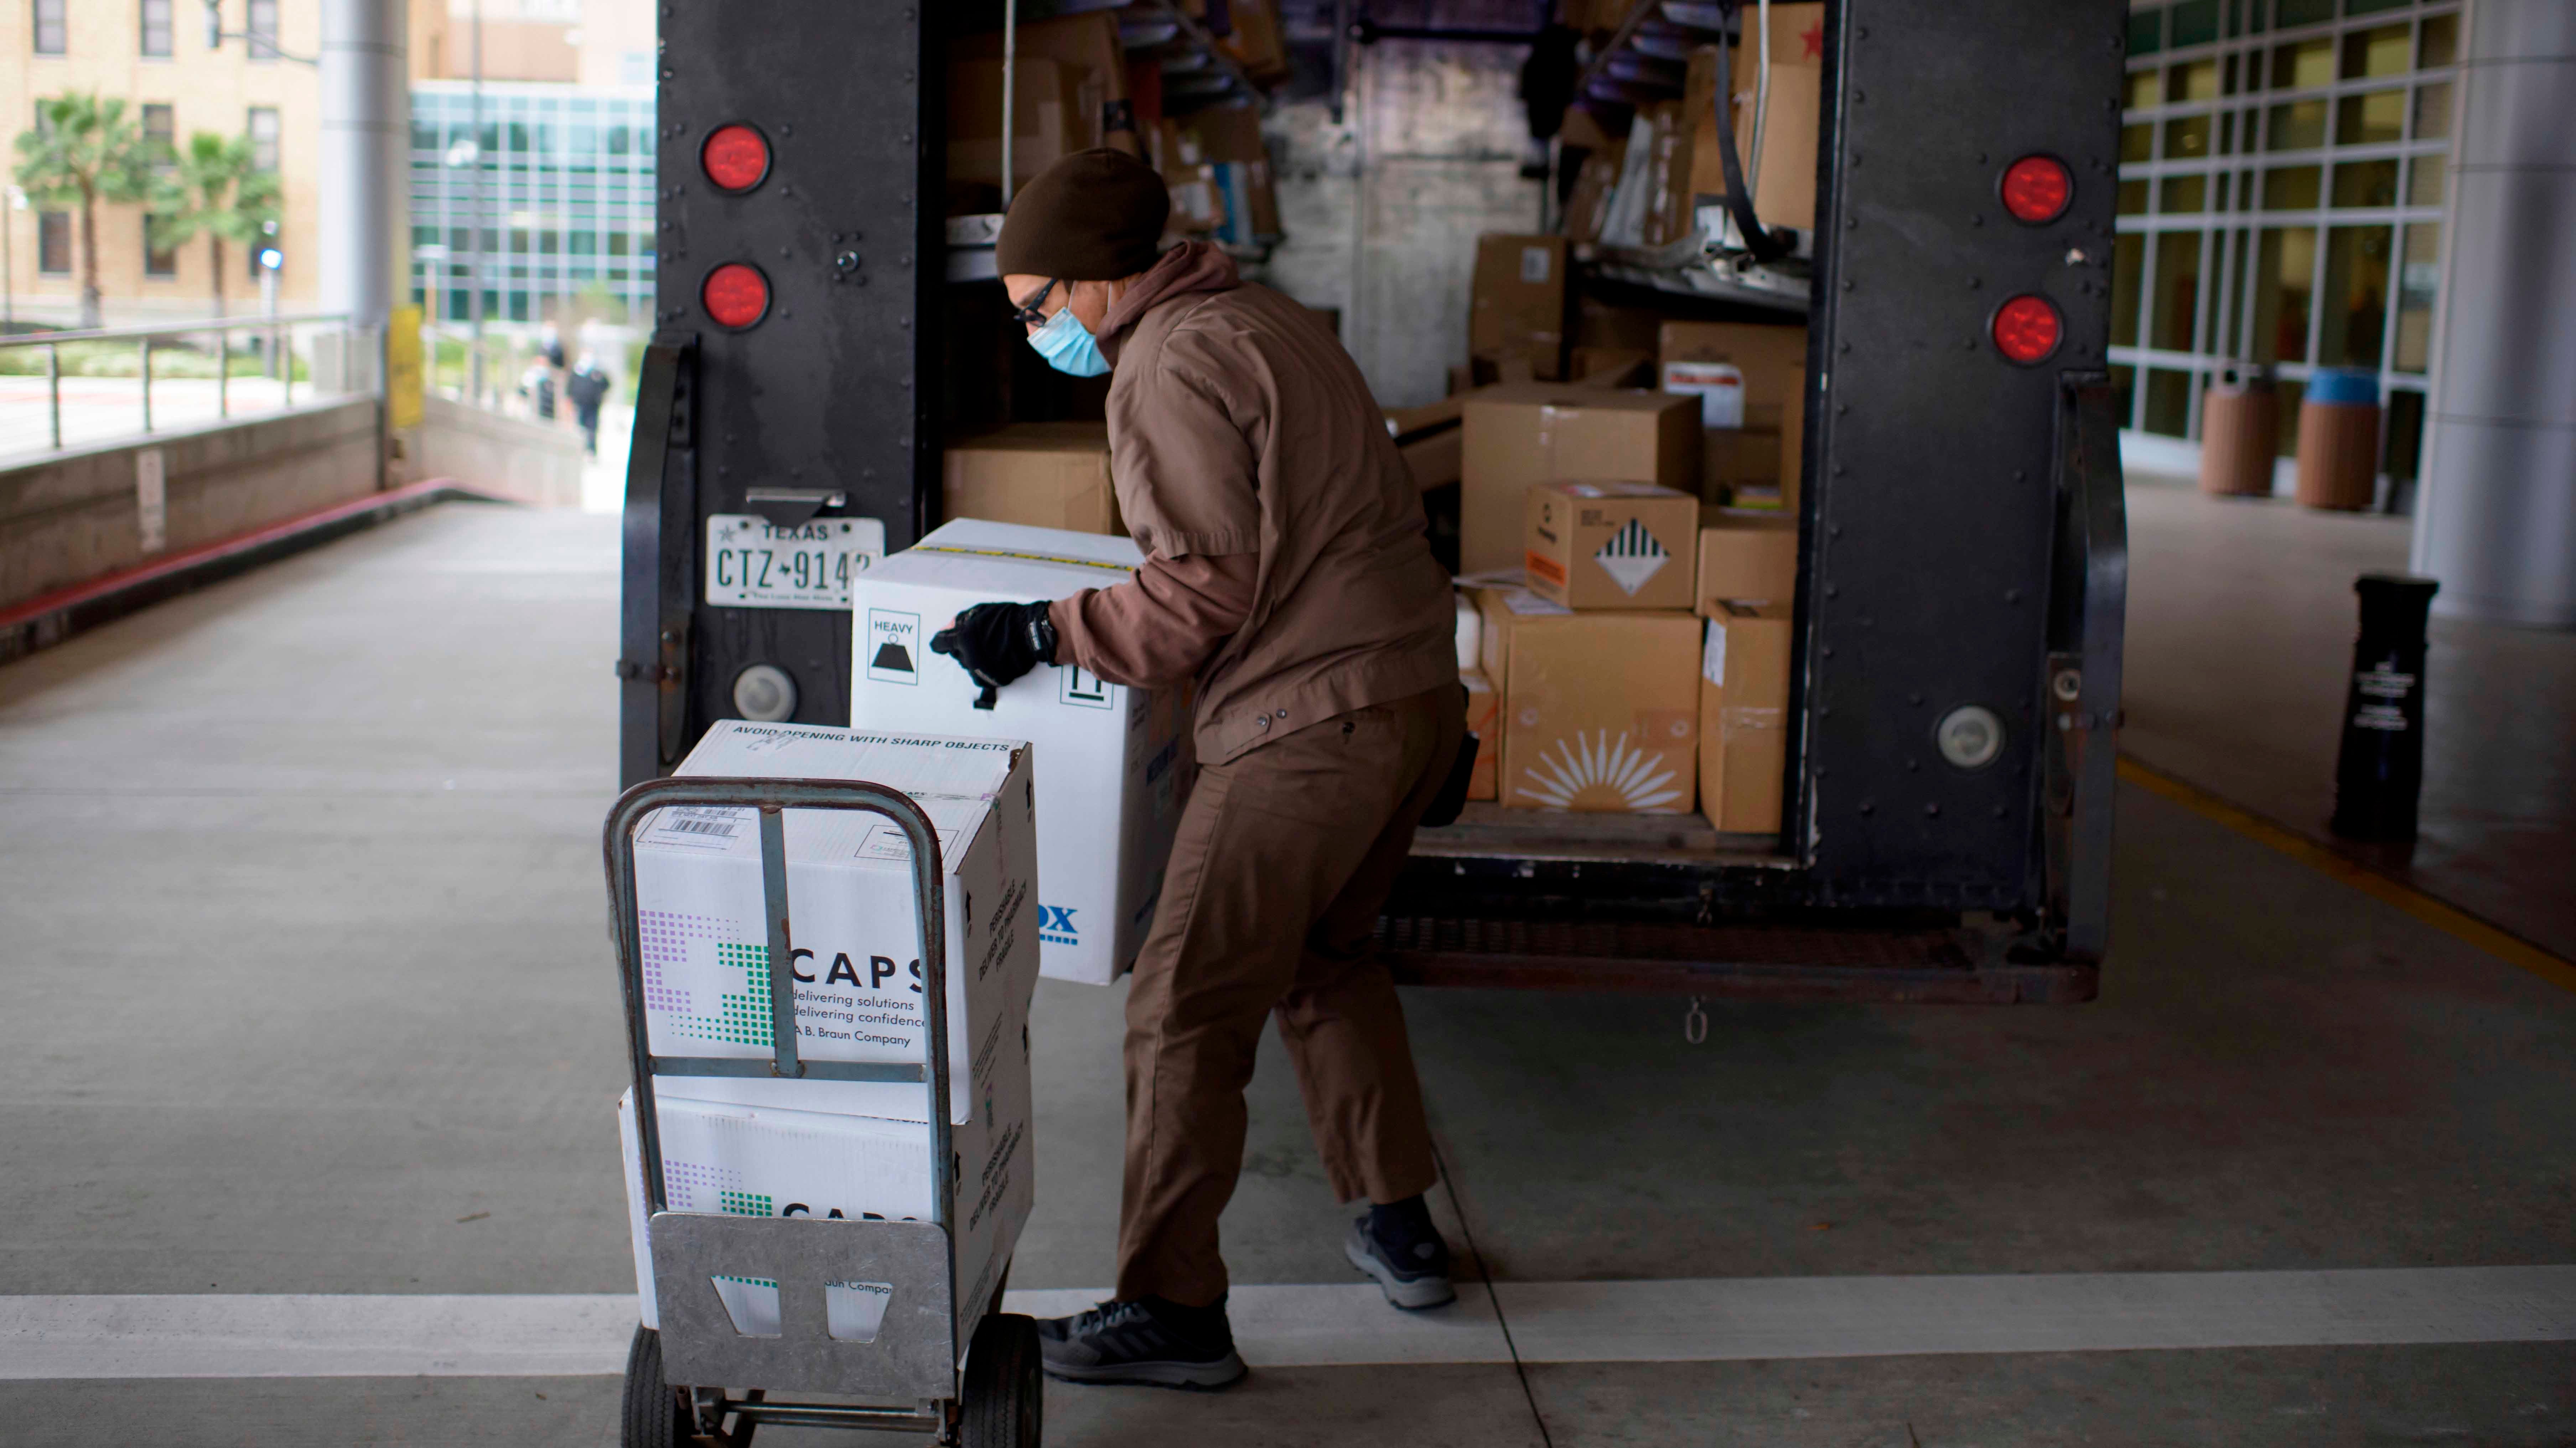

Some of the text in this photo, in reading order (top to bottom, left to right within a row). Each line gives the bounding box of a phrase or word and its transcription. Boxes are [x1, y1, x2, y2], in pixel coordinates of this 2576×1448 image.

[762, 524, 828, 541] TEXAS
[875, 620, 913, 634] HEAVY
[733, 726, 1010, 751] AVOID OPENING WITH SHARP OBJECTS
[793, 989, 914, 1010] delivering solutions
[795, 1005, 854, 1023] delivering
[795, 1026, 911, 1048] A B. Braun Company
[849, 1281, 892, 1295] Compa
